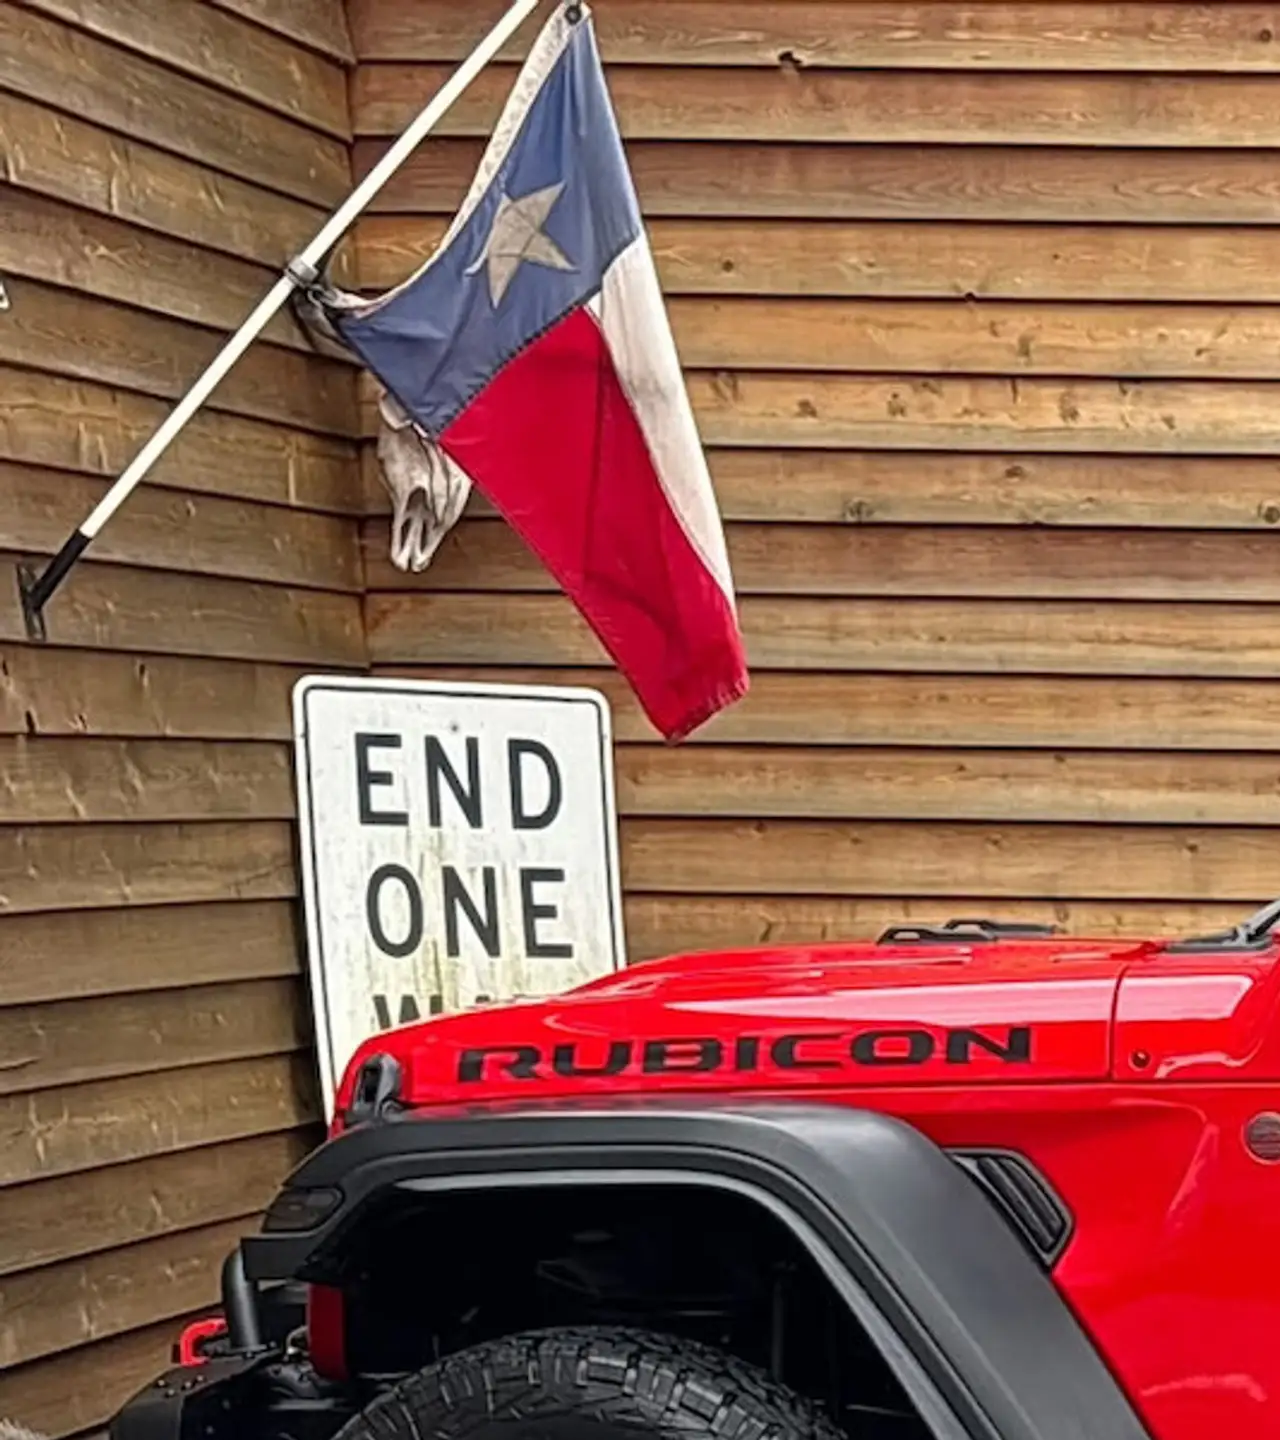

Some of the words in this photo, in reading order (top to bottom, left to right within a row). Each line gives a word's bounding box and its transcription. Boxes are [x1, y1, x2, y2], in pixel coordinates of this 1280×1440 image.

[355, 731, 563, 831] END
[366, 862, 575, 960] ONE
[456, 1026, 1033, 1085] RUBICON
